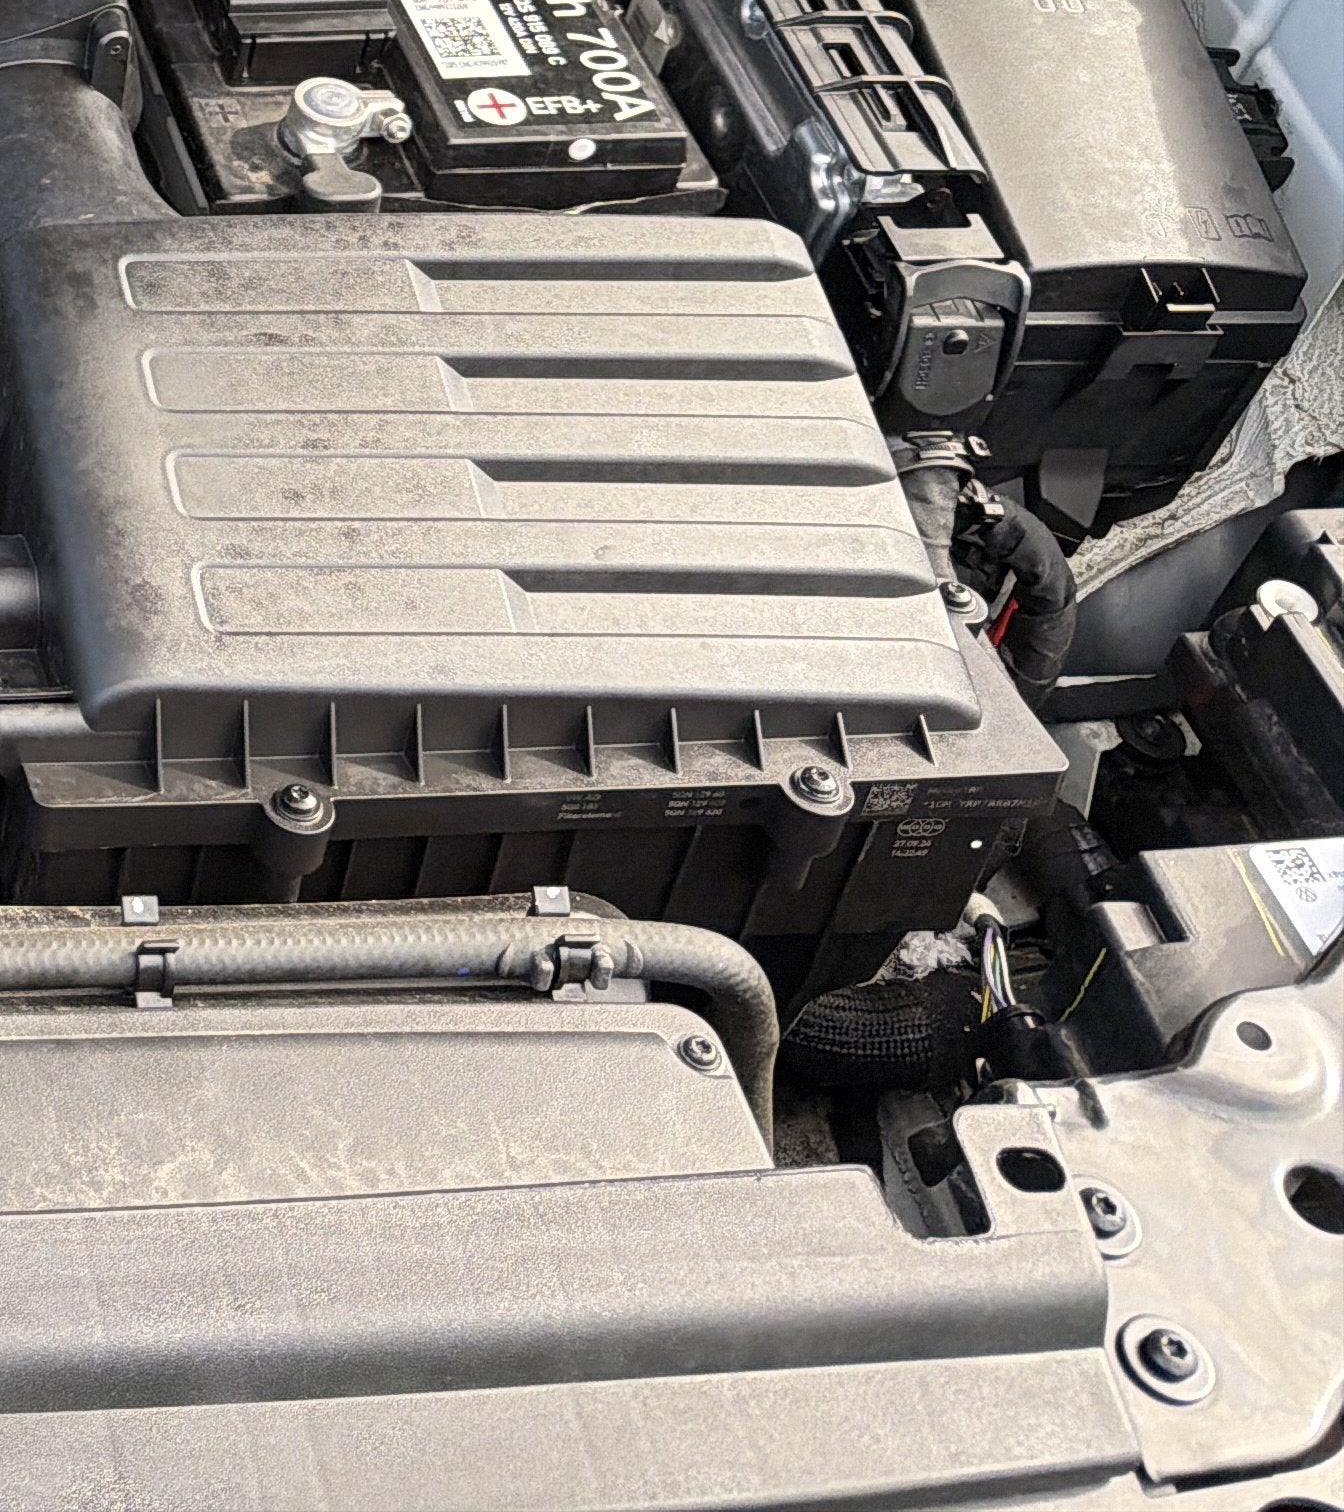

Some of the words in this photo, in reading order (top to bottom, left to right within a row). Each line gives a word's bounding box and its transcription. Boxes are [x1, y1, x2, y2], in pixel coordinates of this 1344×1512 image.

[525, 12, 548, 34] 915
[548, 56, 567, 66] C
[566, 27, 657, 121] 700A
[525, 96, 604, 115] EFB+
[915, 350, 933, 391] BOSCH
